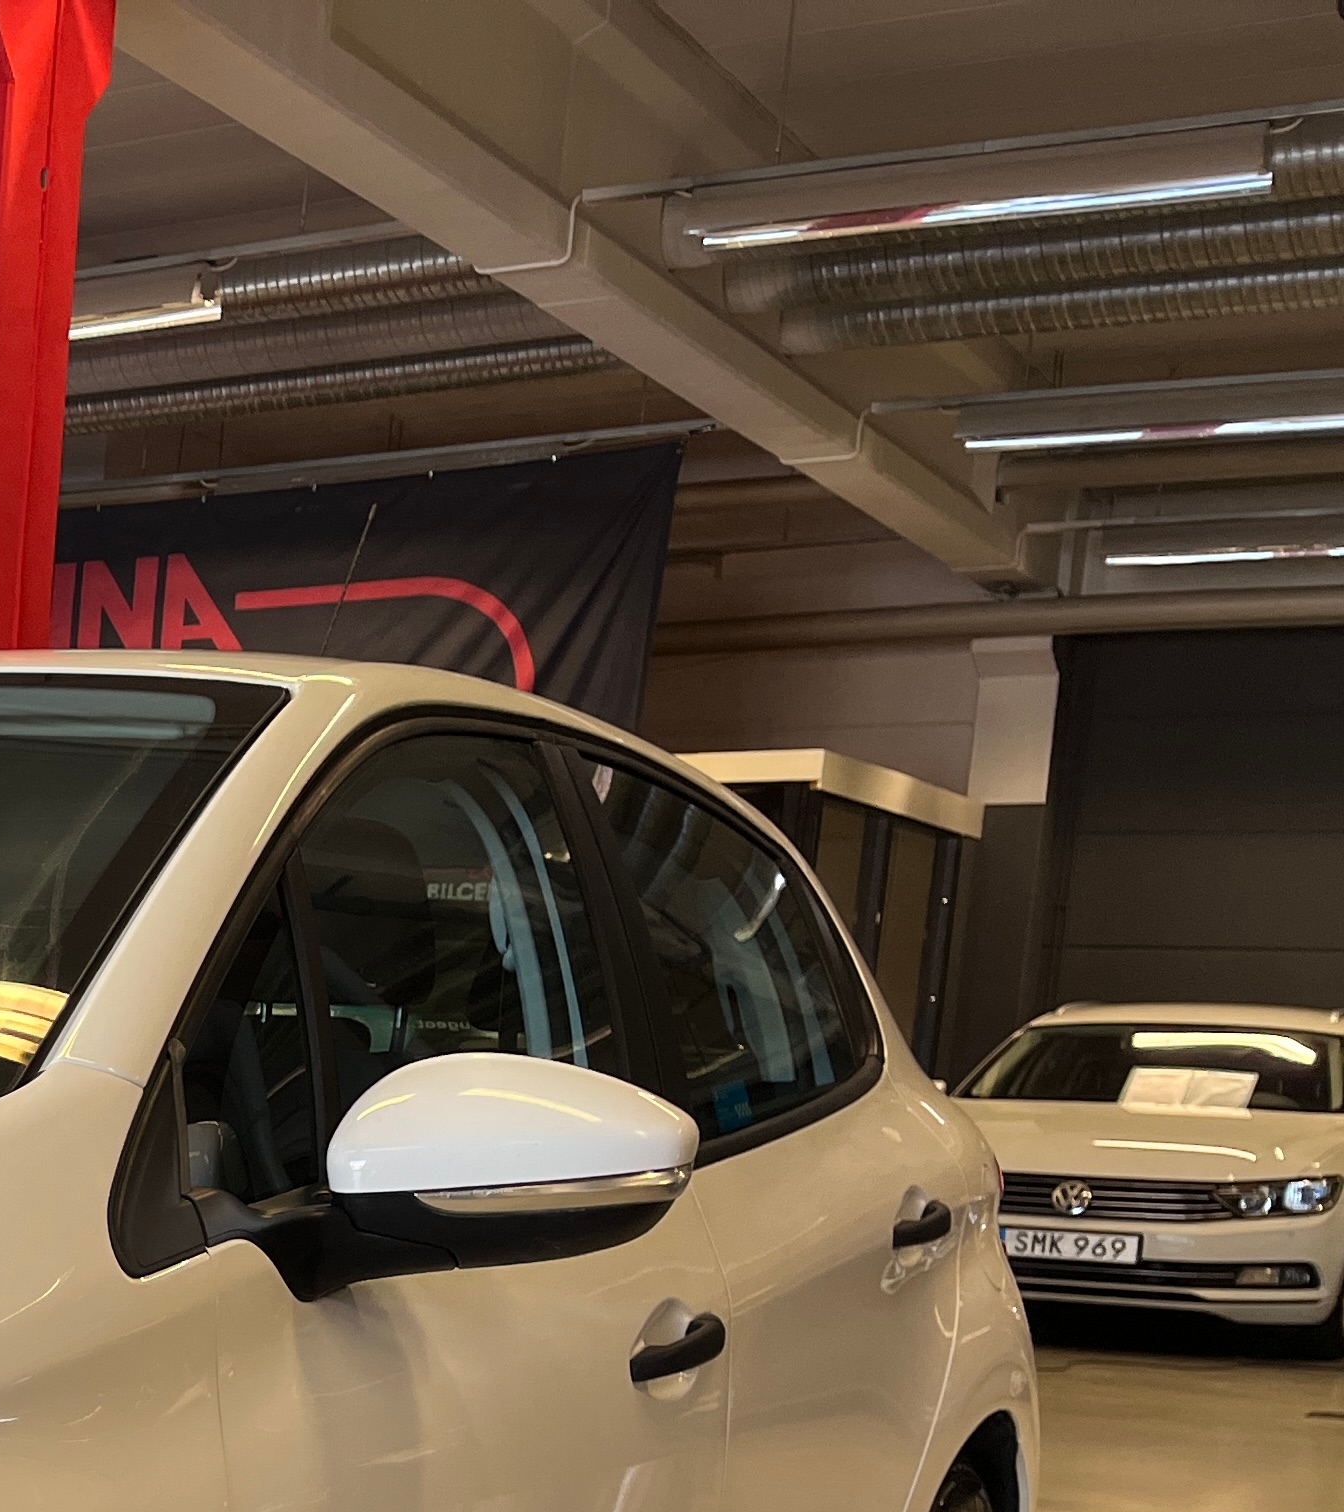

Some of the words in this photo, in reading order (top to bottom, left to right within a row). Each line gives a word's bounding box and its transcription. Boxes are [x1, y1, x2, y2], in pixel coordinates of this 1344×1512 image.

[426, 882, 492, 901] BILCE
[1013, 1231, 1062, 1255] SMK
[1073, 1237, 1128, 1258] 969
